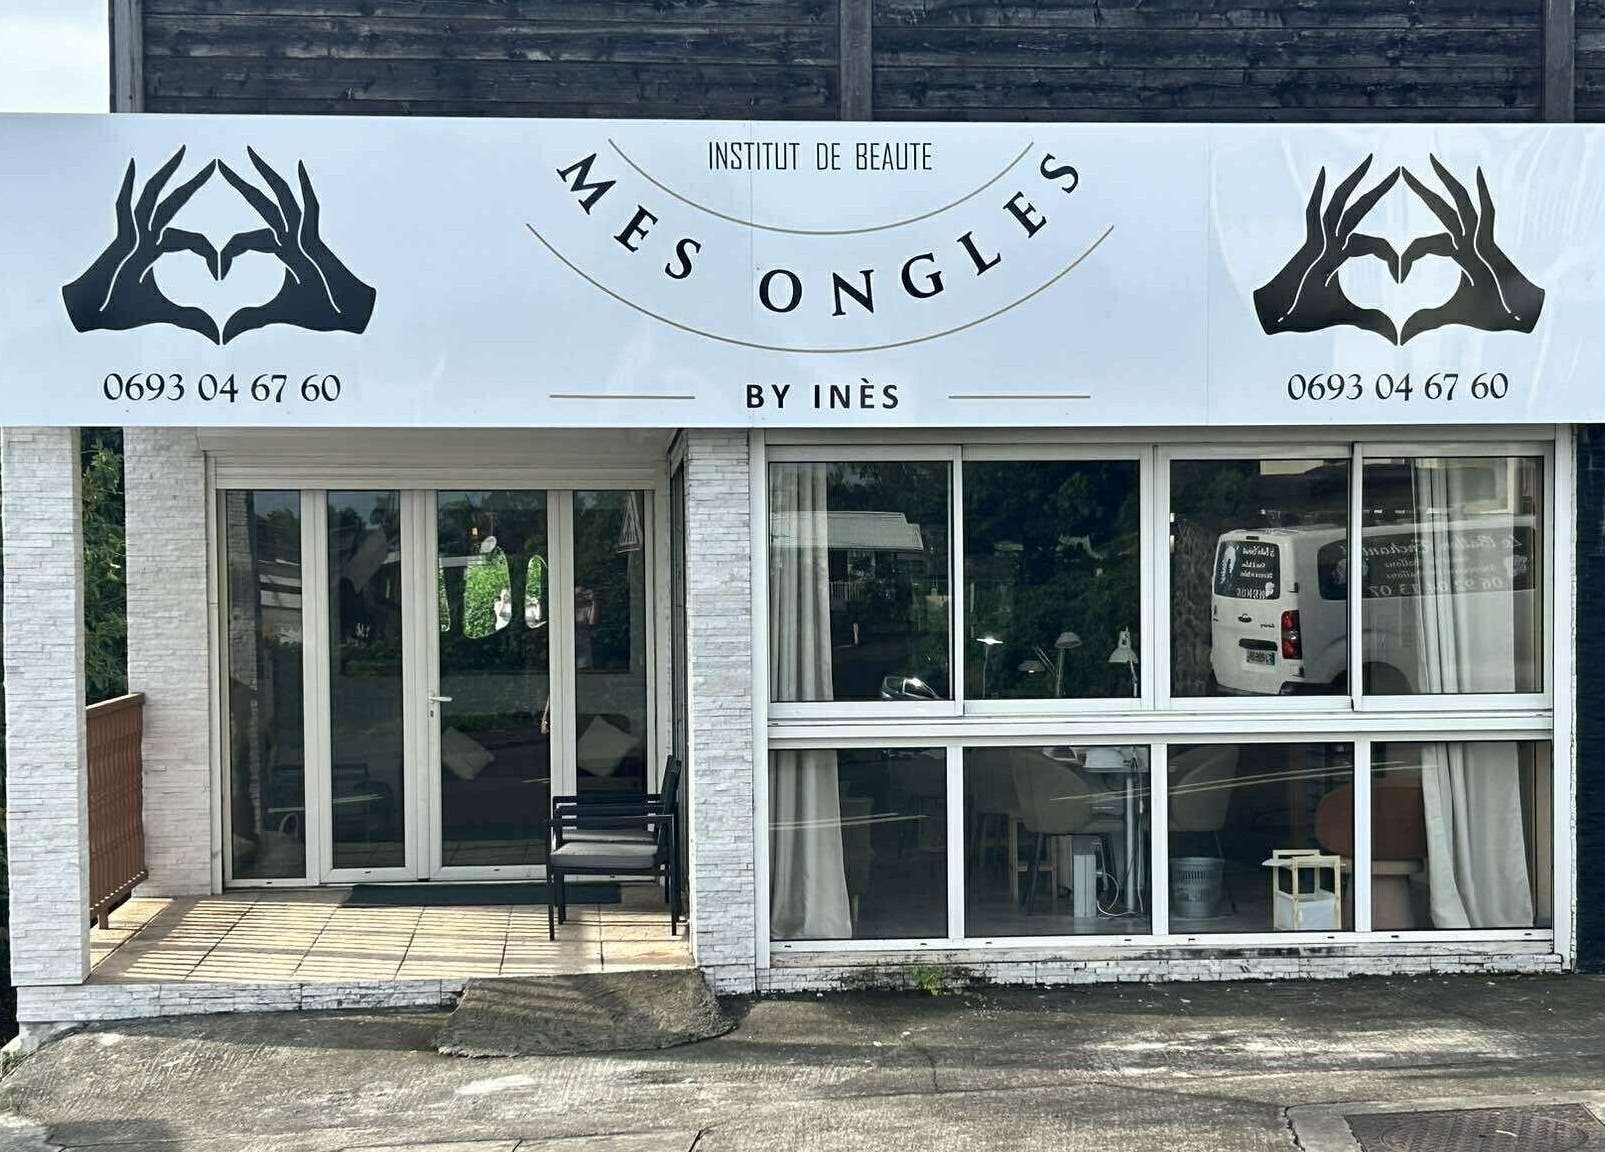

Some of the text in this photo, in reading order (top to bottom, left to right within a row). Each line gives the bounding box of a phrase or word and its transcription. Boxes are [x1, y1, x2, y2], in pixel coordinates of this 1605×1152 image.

[709, 141, 933, 171] INSTITUT DE BEAUTE
[556, 152, 1080, 317] MES ONGLES
[103, 372, 341, 403] 0693 04 67 60
[746, 379, 900, 410] BY INÈS
[1287, 372, 1509, 402] 0693 04 67 60
